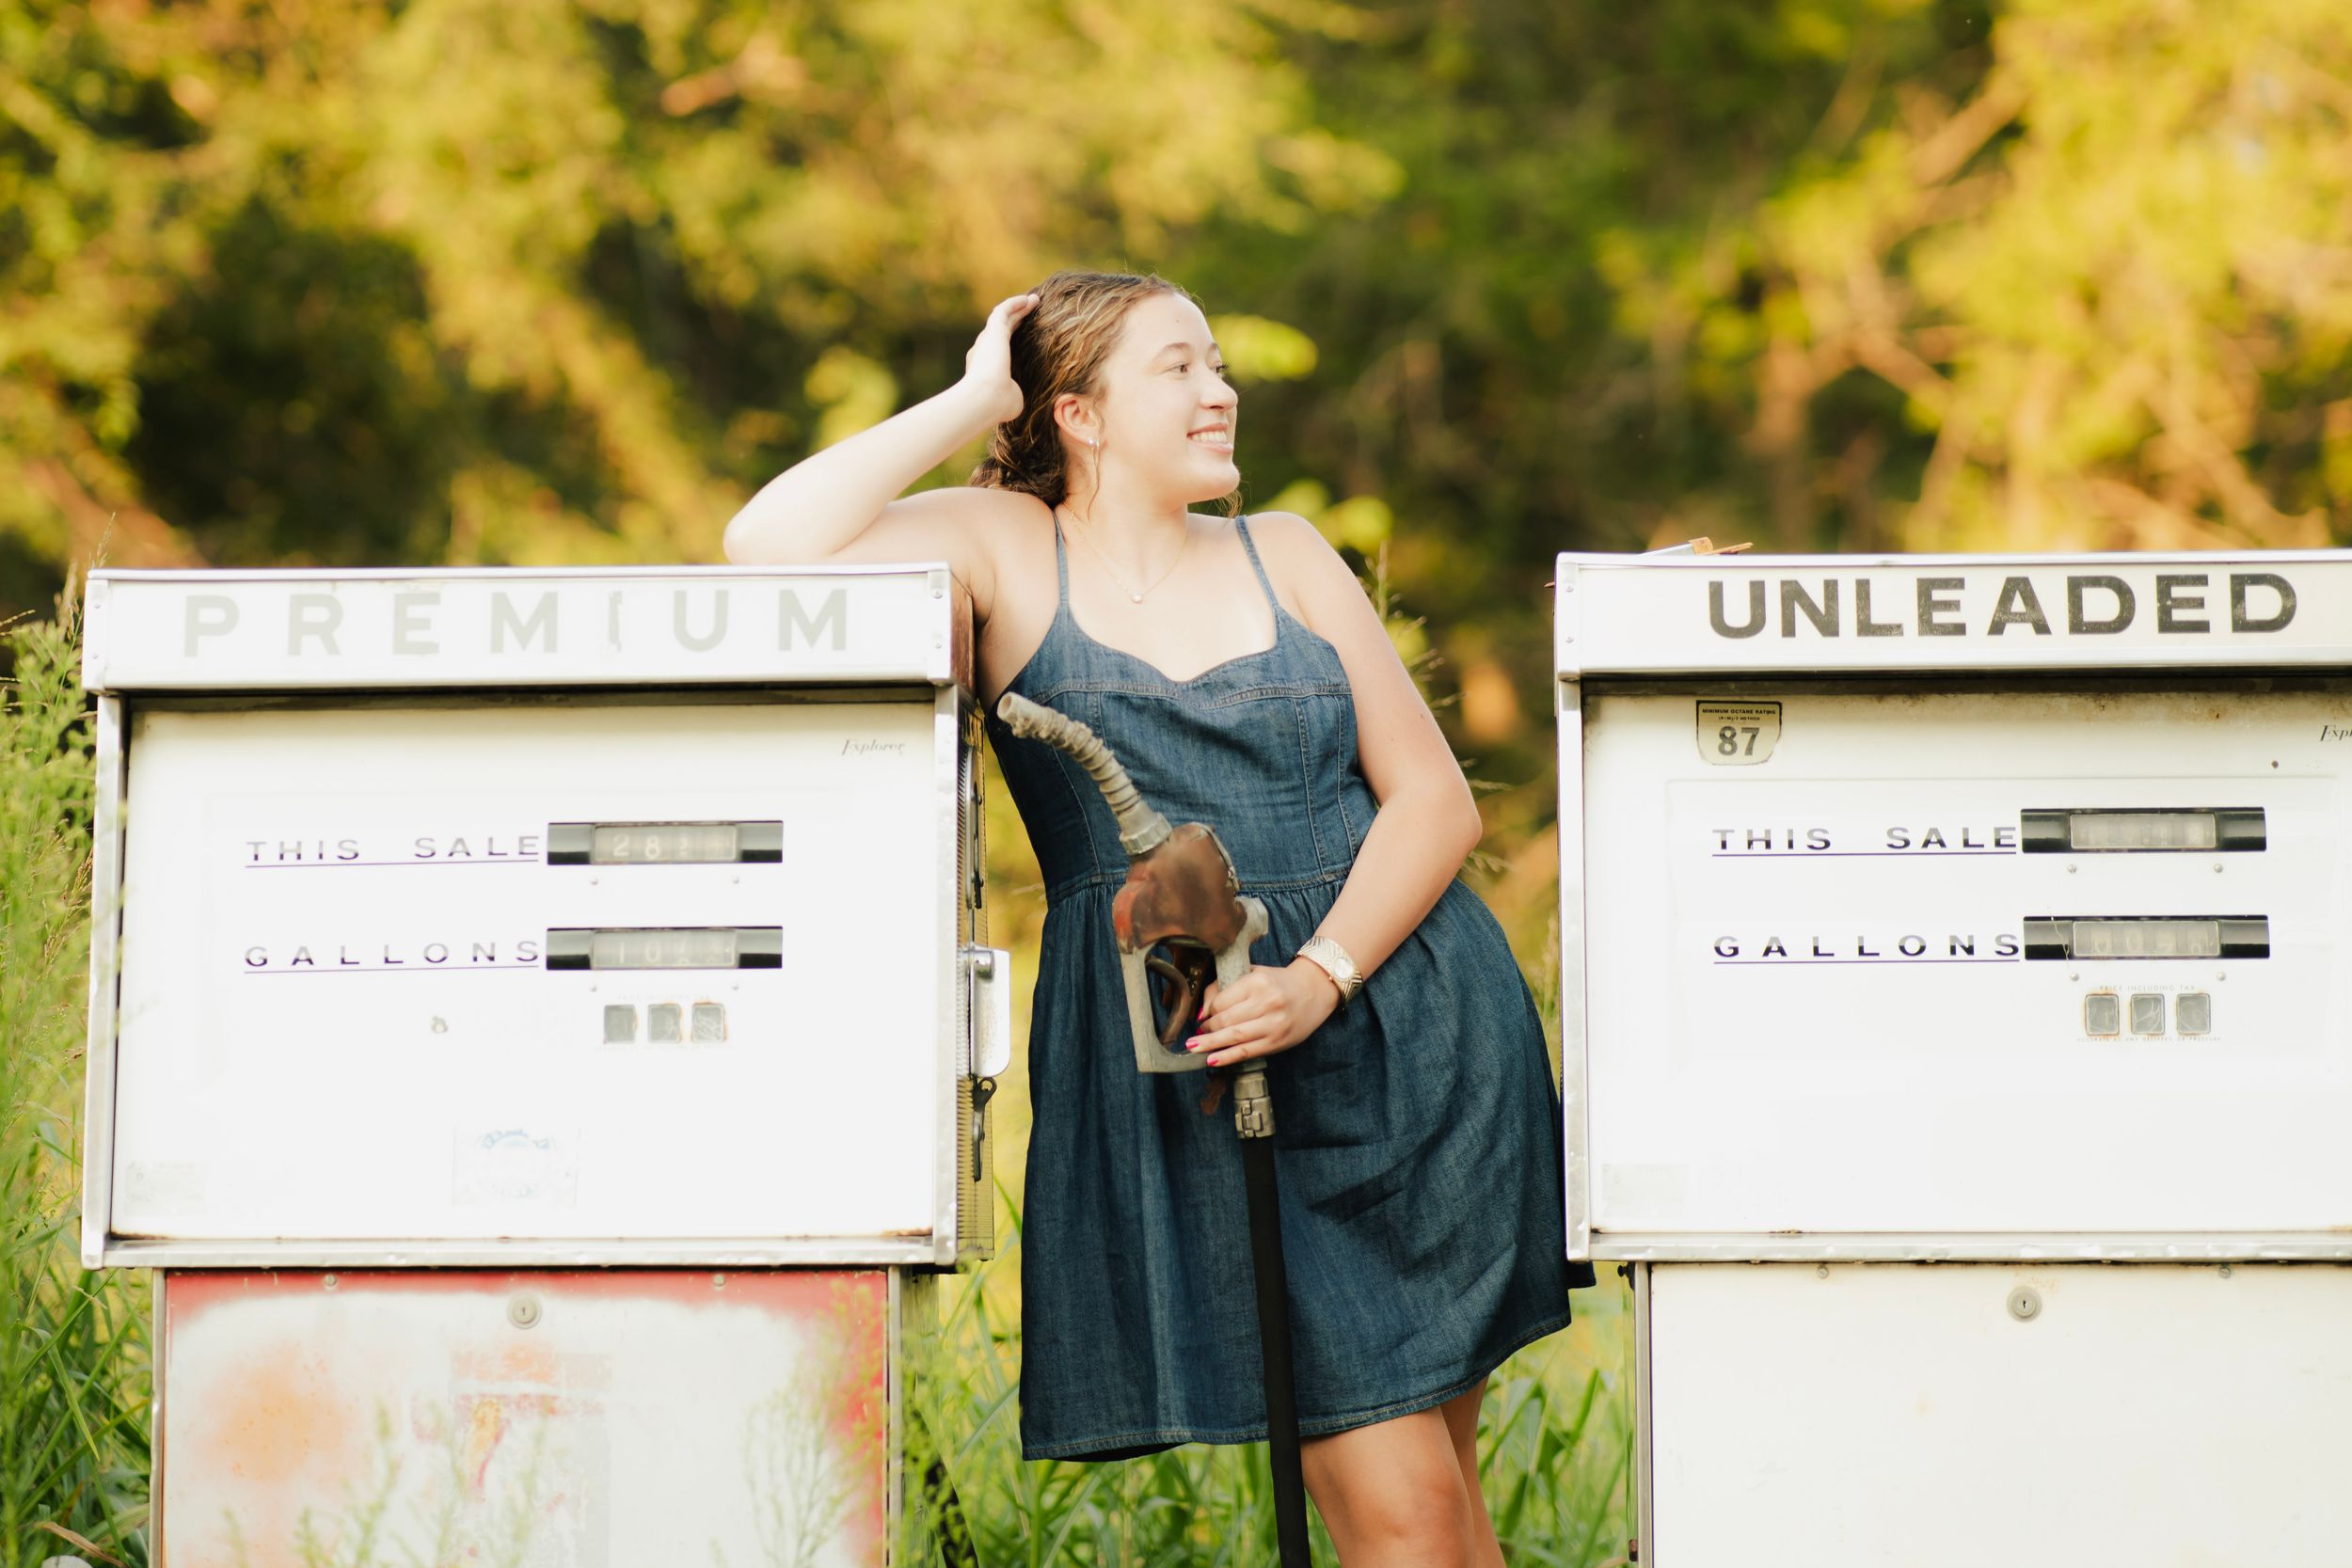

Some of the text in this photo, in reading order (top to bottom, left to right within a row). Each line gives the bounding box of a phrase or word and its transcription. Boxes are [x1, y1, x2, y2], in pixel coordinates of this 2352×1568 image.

[1709, 574, 2296, 639] UNLEADED
[183, 588, 848, 658] PREMIUM
[1718, 725, 1760, 756] 87
[246, 835, 541, 862] THIS SALE
[1712, 826, 2017, 851] THIS SALE
[245, 941, 539, 967] GALLONS
[1713, 934, 2020, 958] GALLONS
